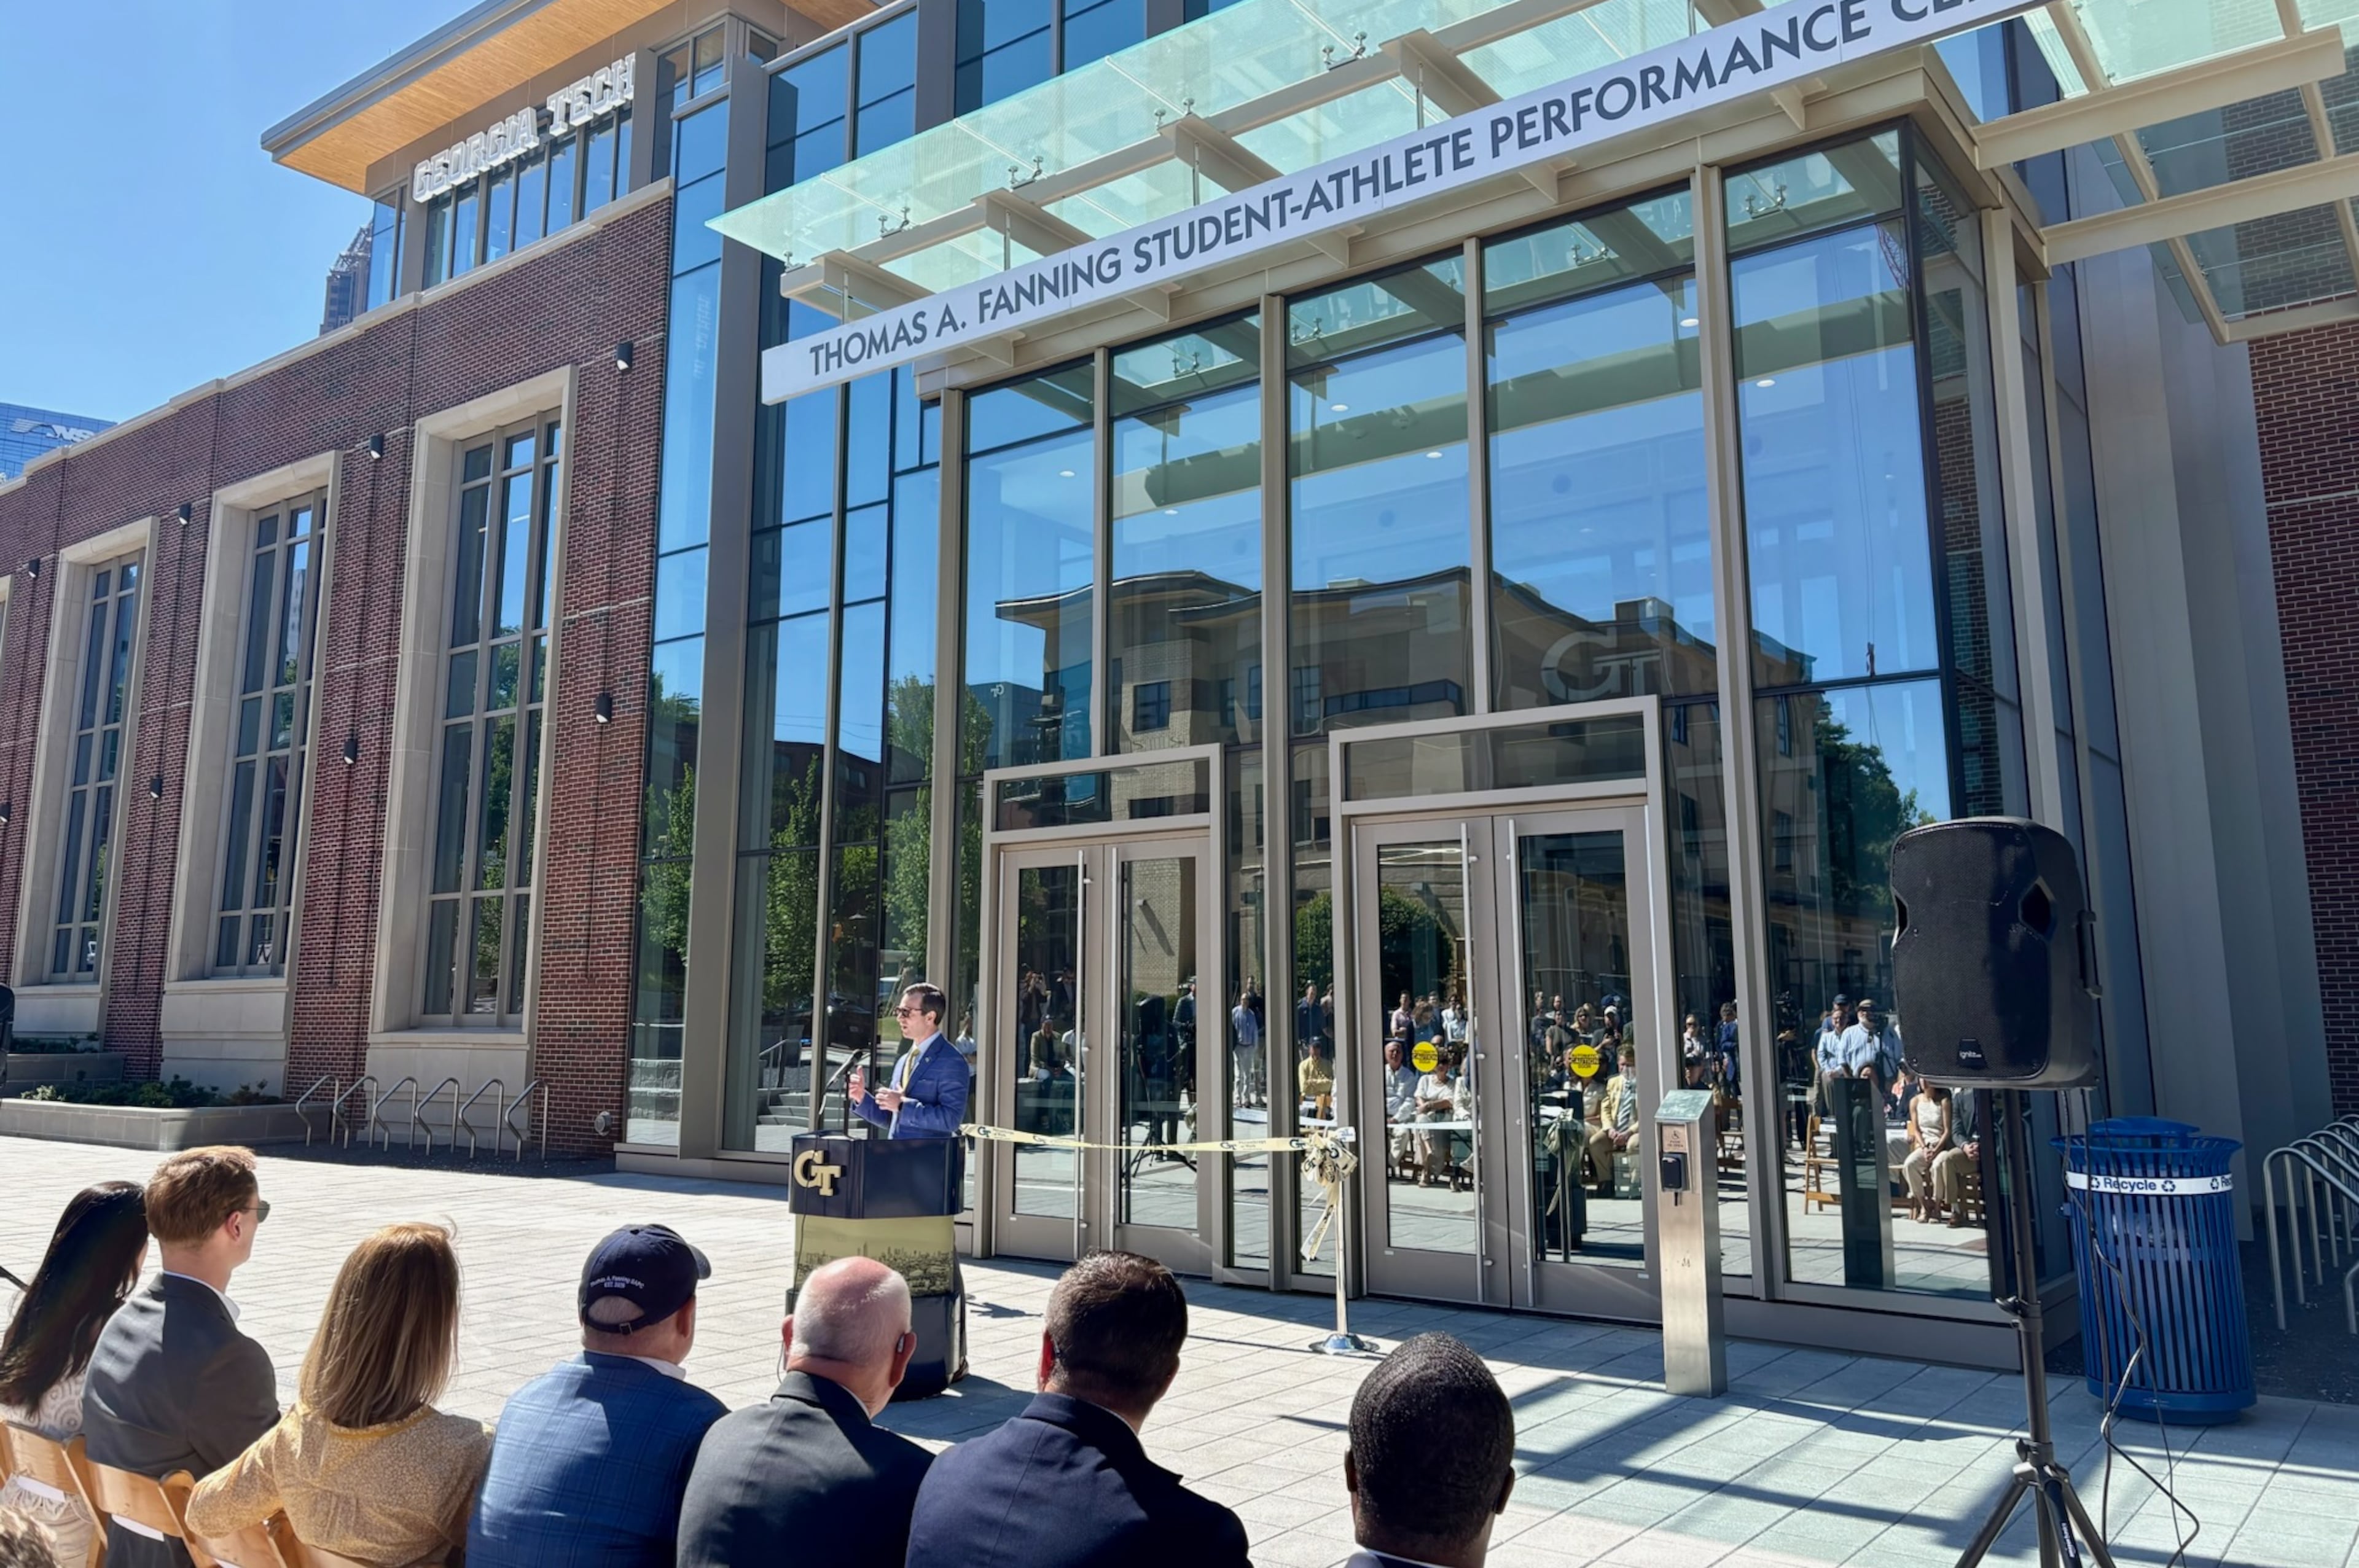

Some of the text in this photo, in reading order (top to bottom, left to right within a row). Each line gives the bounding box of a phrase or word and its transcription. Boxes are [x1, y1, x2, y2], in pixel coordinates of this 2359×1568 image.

[412, 52, 636, 203] GEORGIA TECH
[810, 0, 1872, 376] THOMAS A. FANNING STUDENT-ATHLETE PERFORMANCE
[794, 1150, 842, 1196] GT
[2103, 1177, 2157, 1192] Recycle
